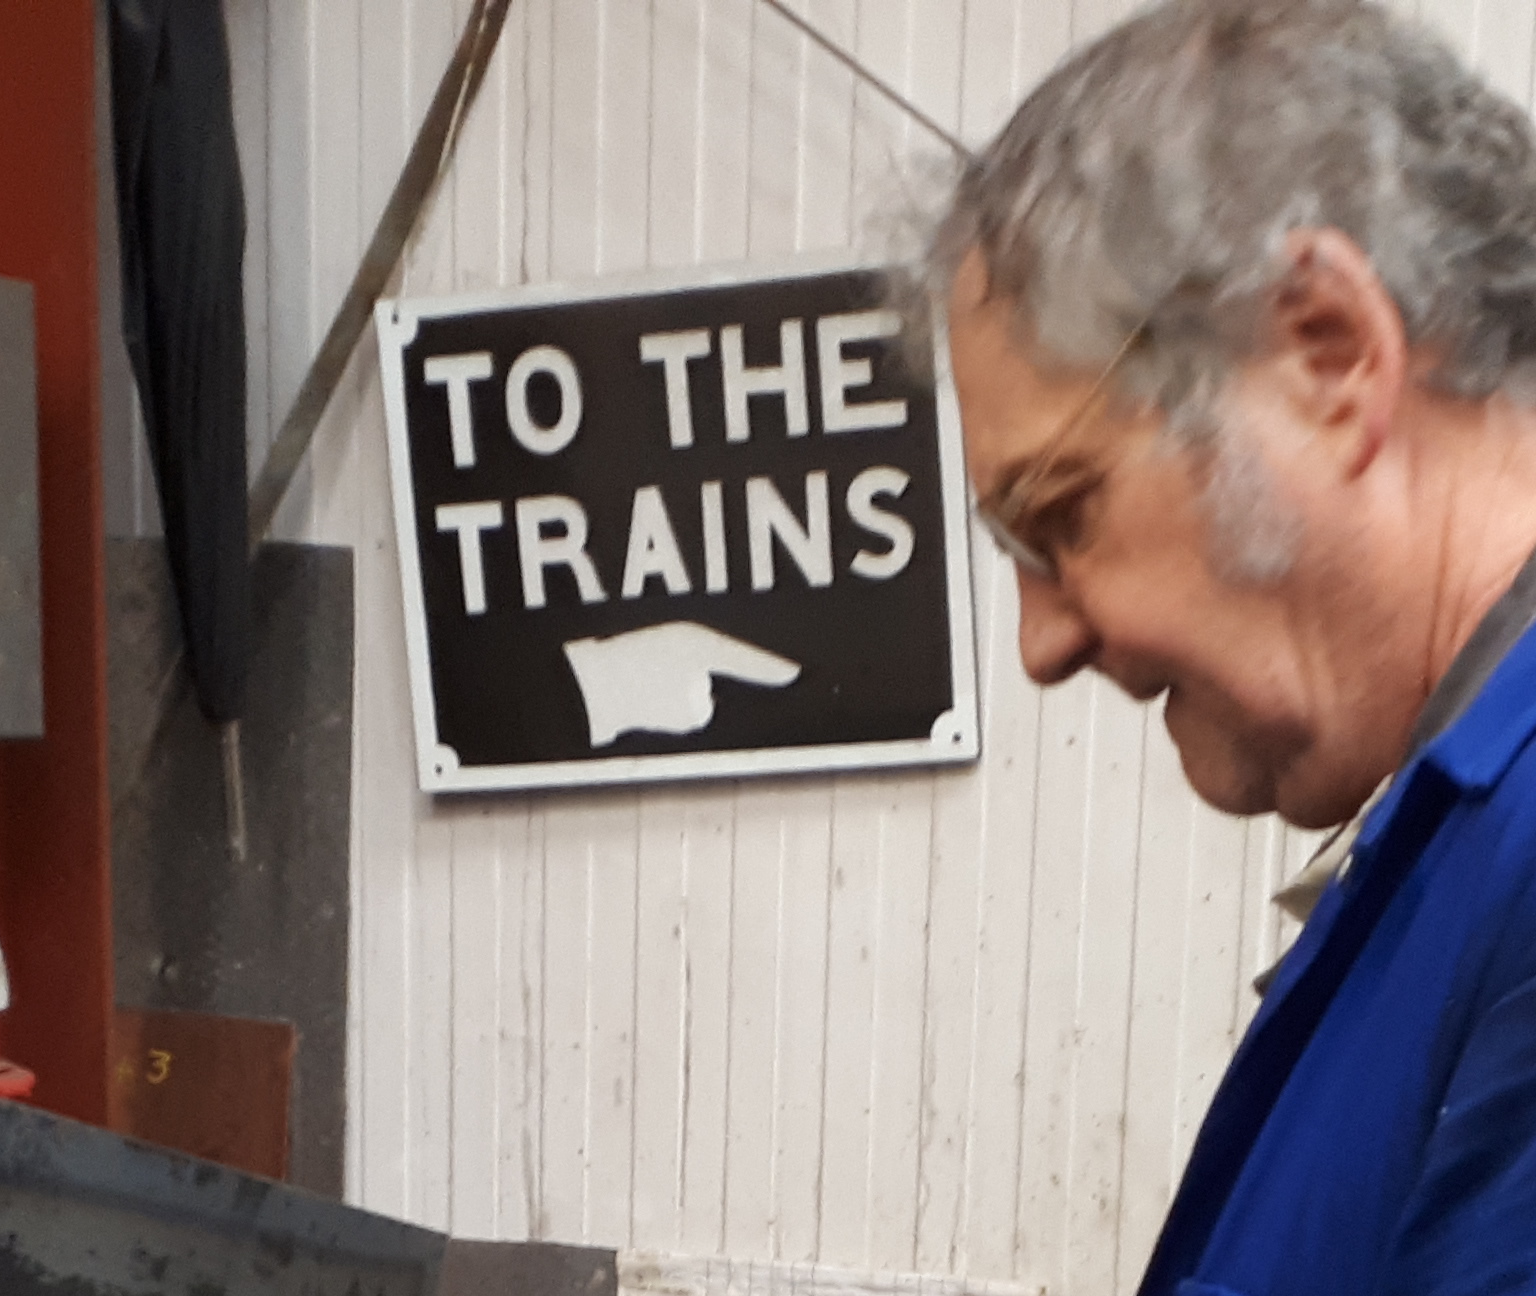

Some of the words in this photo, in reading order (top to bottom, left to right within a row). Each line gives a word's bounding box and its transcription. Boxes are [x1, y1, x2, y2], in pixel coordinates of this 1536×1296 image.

[423, 344, 584, 470] TO
[638, 309, 909, 450] THE
[434, 465, 916, 615] TRAINS
